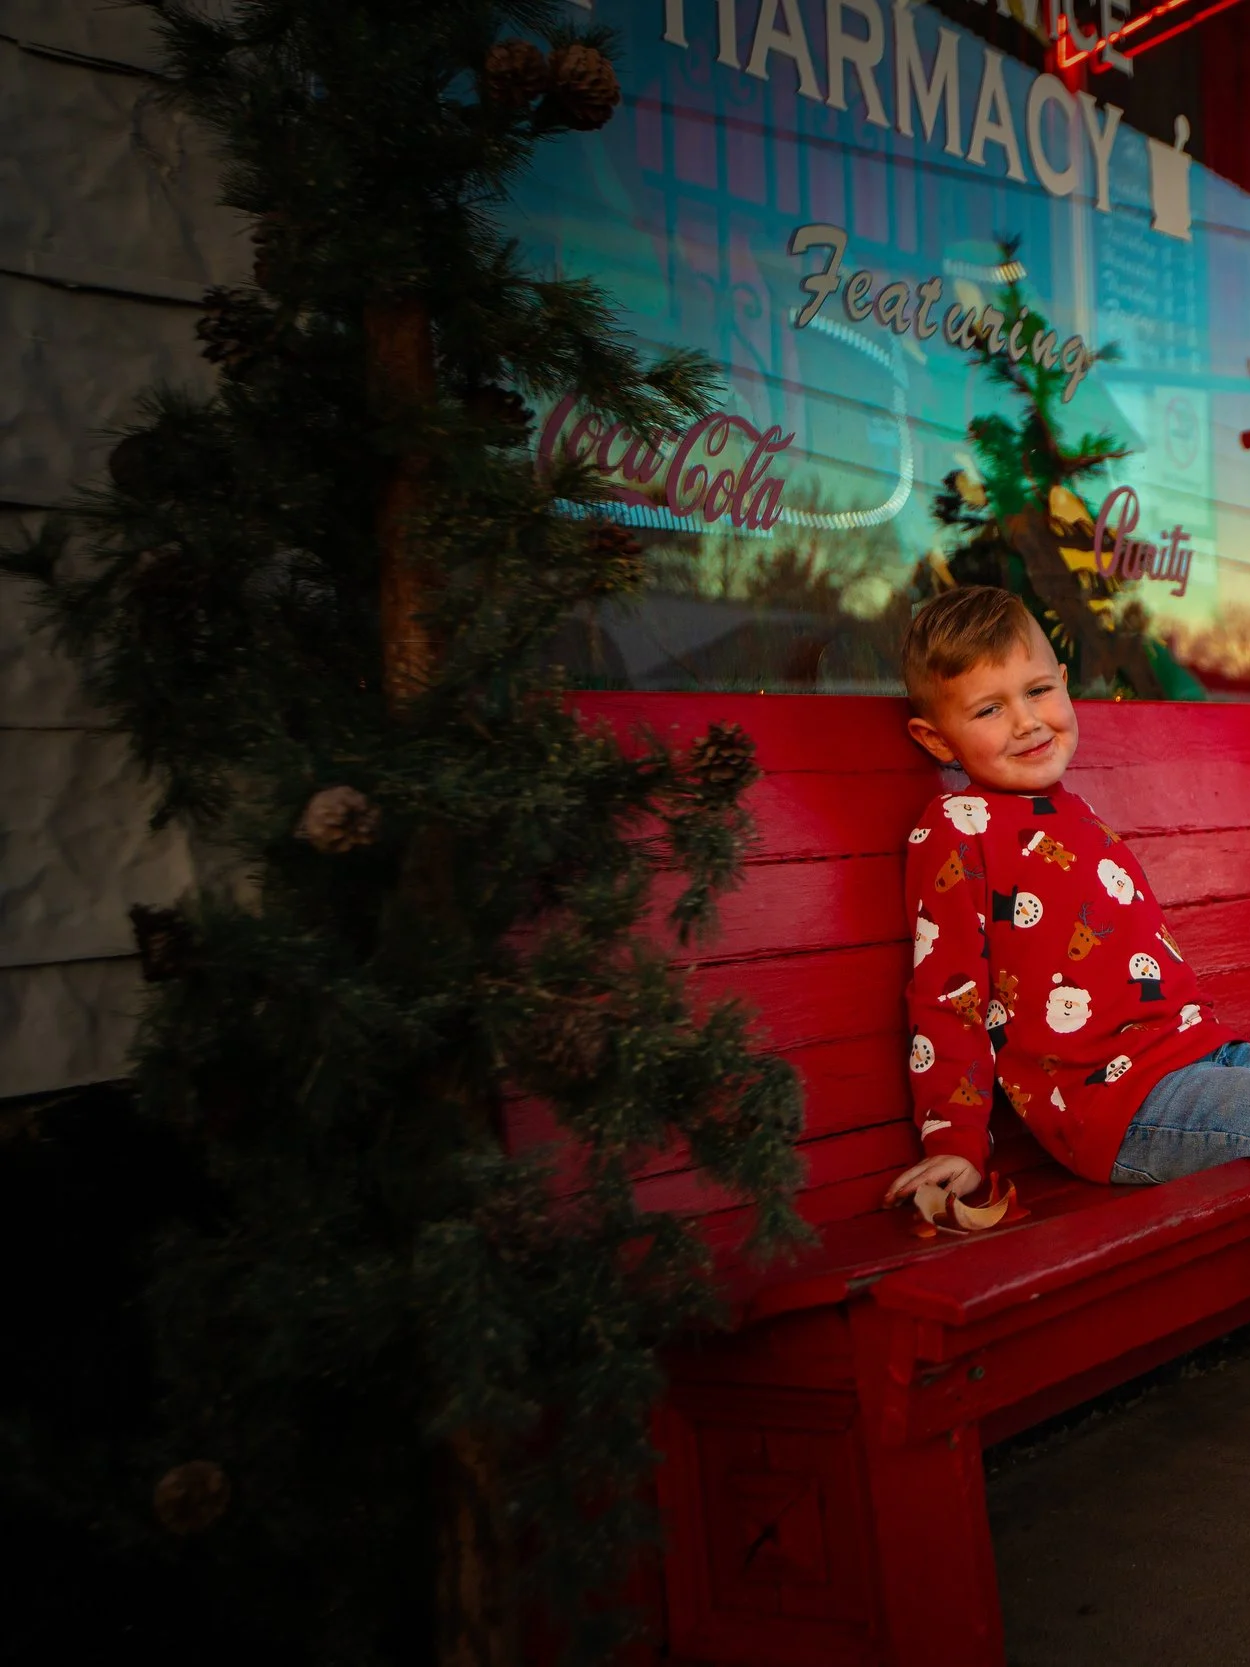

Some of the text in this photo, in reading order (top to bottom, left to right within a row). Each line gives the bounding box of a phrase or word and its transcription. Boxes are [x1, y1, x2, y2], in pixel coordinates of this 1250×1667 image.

[569, 0, 1125, 214] ARMACY
[787, 223, 1089, 404] Featuring
[1094, 485, 1195, 597] Purity
